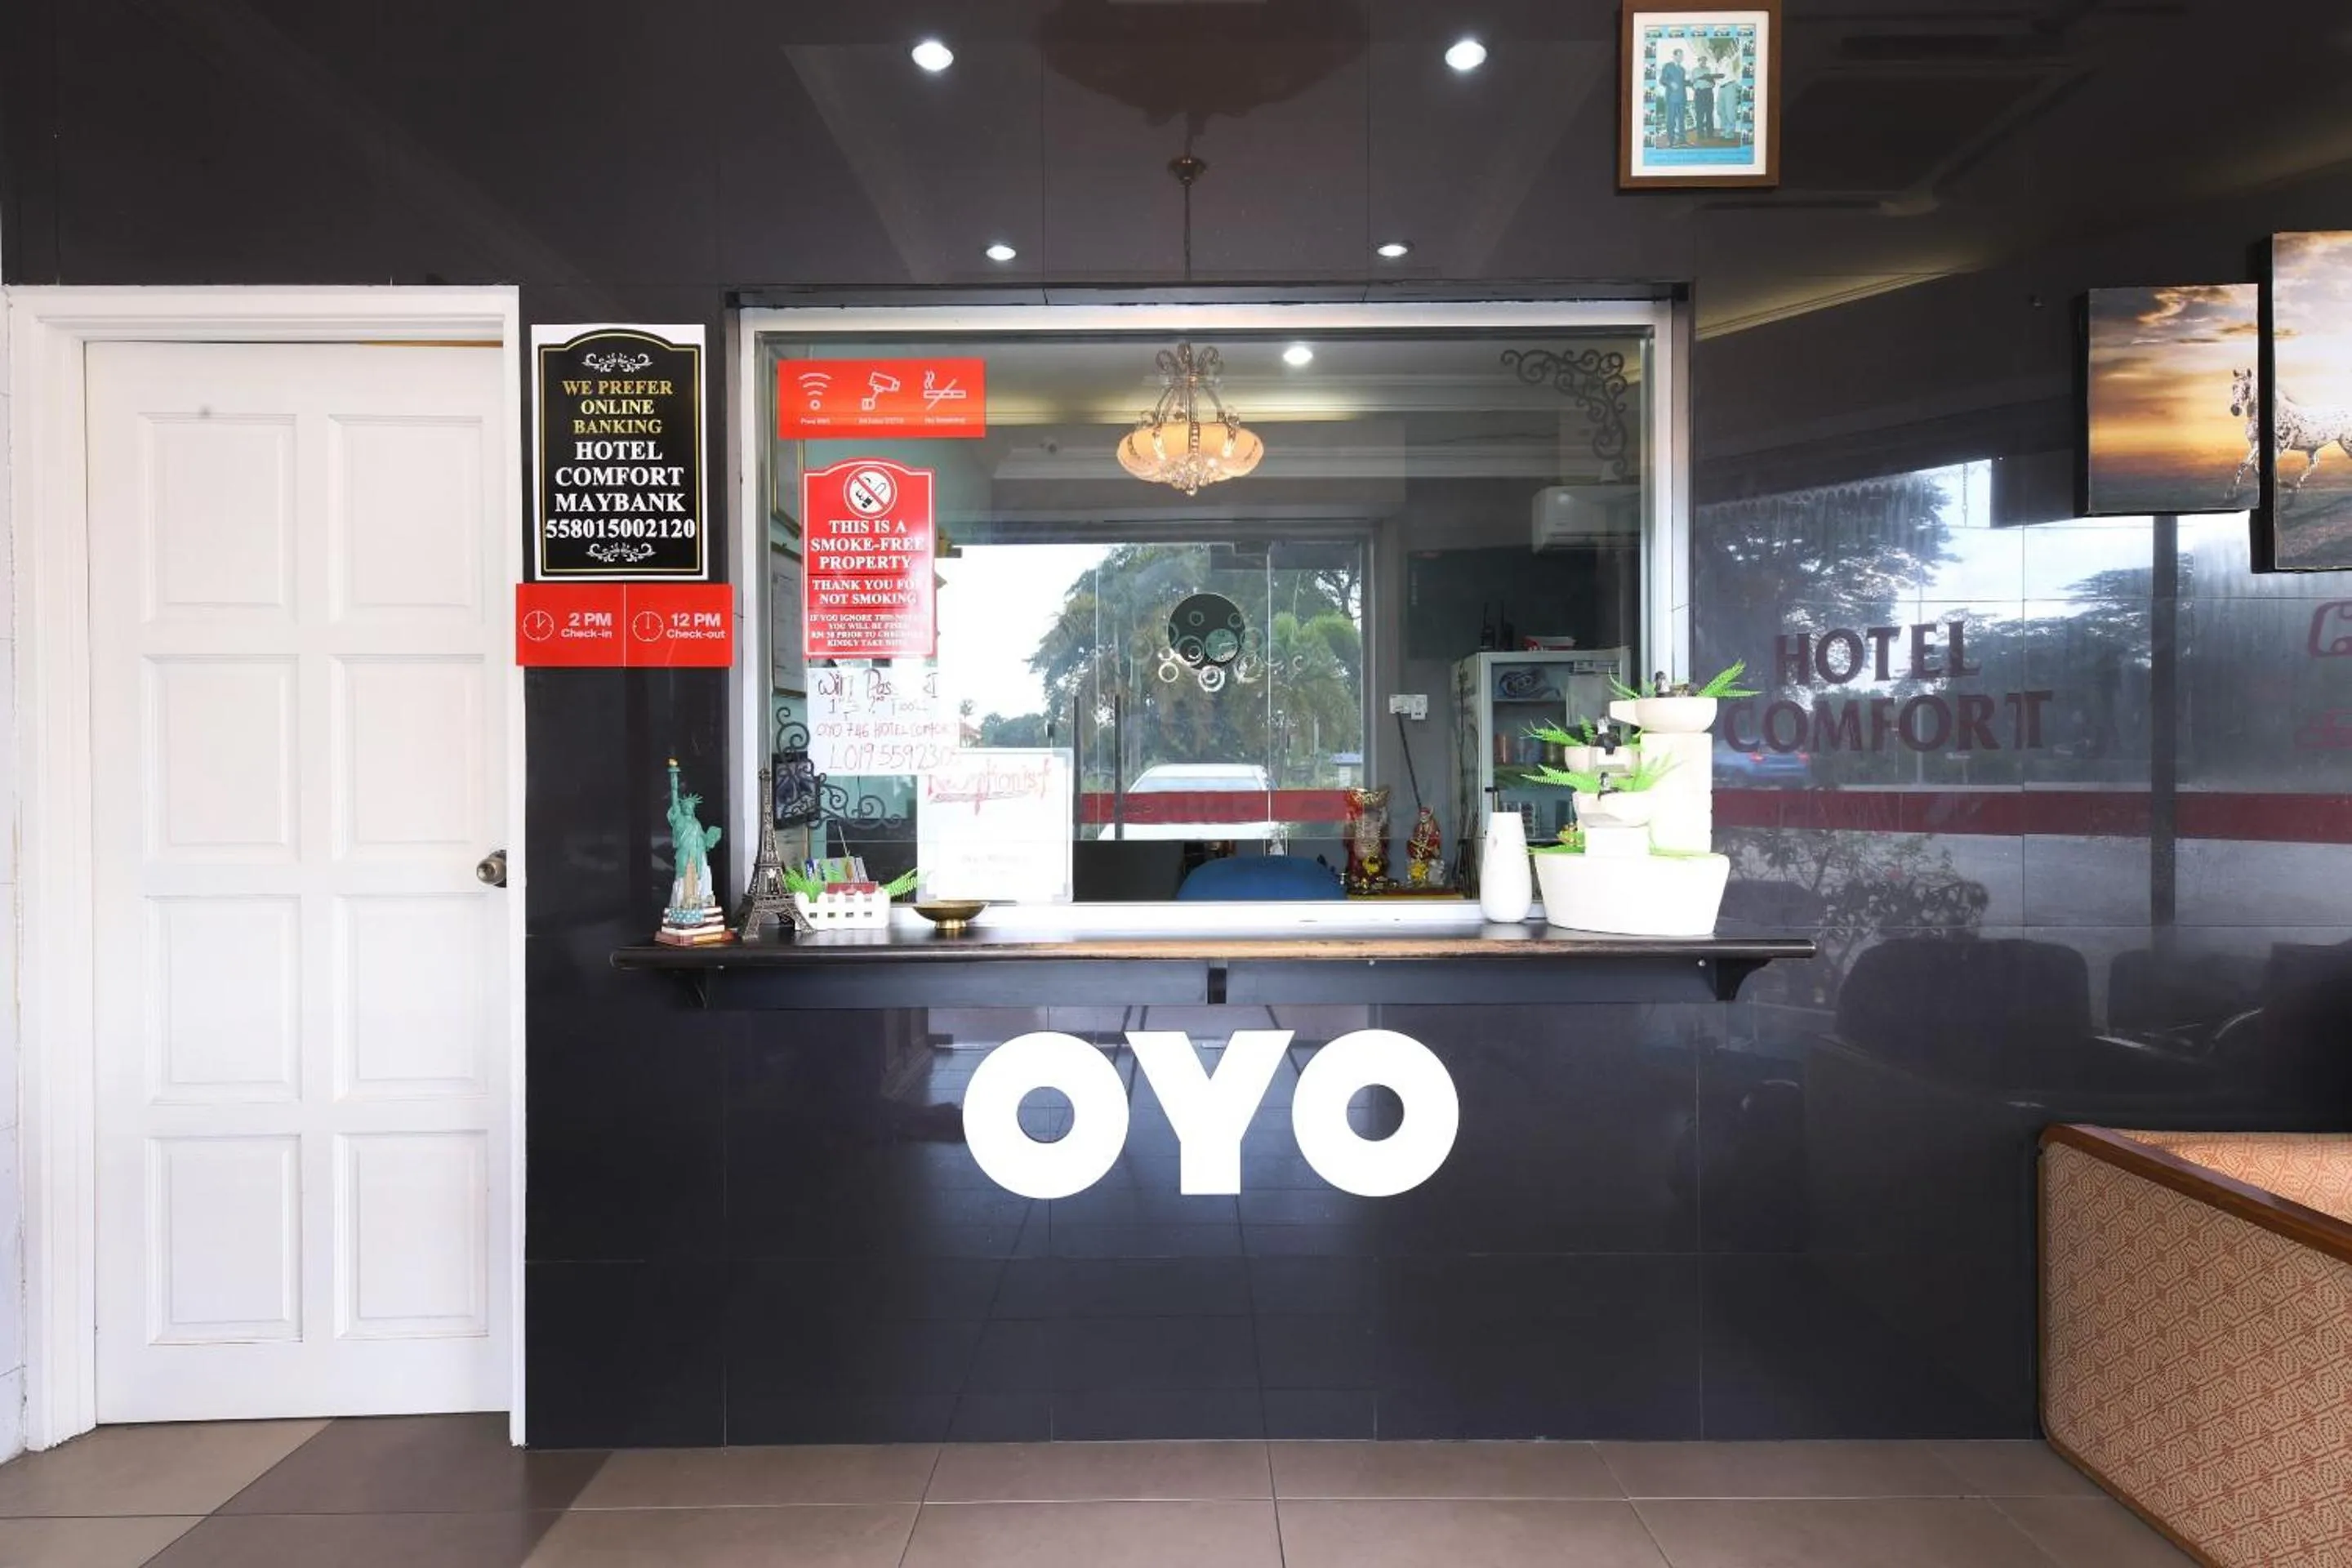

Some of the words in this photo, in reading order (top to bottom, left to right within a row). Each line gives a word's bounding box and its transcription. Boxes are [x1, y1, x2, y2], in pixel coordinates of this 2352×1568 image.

[563, 380, 592, 396] WE
[599, 380, 673, 395] PREFER
[581, 399, 655, 416] ONLINE
[573, 419, 662, 434] BANKING
[575, 441, 662, 461] HOTEL
[555, 466, 684, 488] COMFORT
[555, 492, 685, 513] MAYBANK
[546, 518, 696, 540] 558015002120
[829, 520, 869, 533] THIS
[875, 520, 890, 533] IS
[896, 520, 906, 533] A
[811, 538, 924, 551] SMOKE-FREE
[819, 556, 912, 570] PROPERTY
[812, 579, 861, 590] THANK
[864, 579, 893, 590] YOU
[897, 579, 923, 590] FO
[819, 593, 849, 604] NOT
[852, 593, 917, 605] SMOKING
[568, 613, 582, 626] 2
[586, 613, 612, 626] PM
[670, 613, 688, 626] 12
[690, 613, 721, 626] PM
[561, 628, 612, 639] Check-in
[666, 628, 726, 639] Check-out
[1774, 621, 1981, 686] HOTEL
[1723, 689, 2054, 753] COMFORT
[962, 1029, 1459, 1199] OYO
